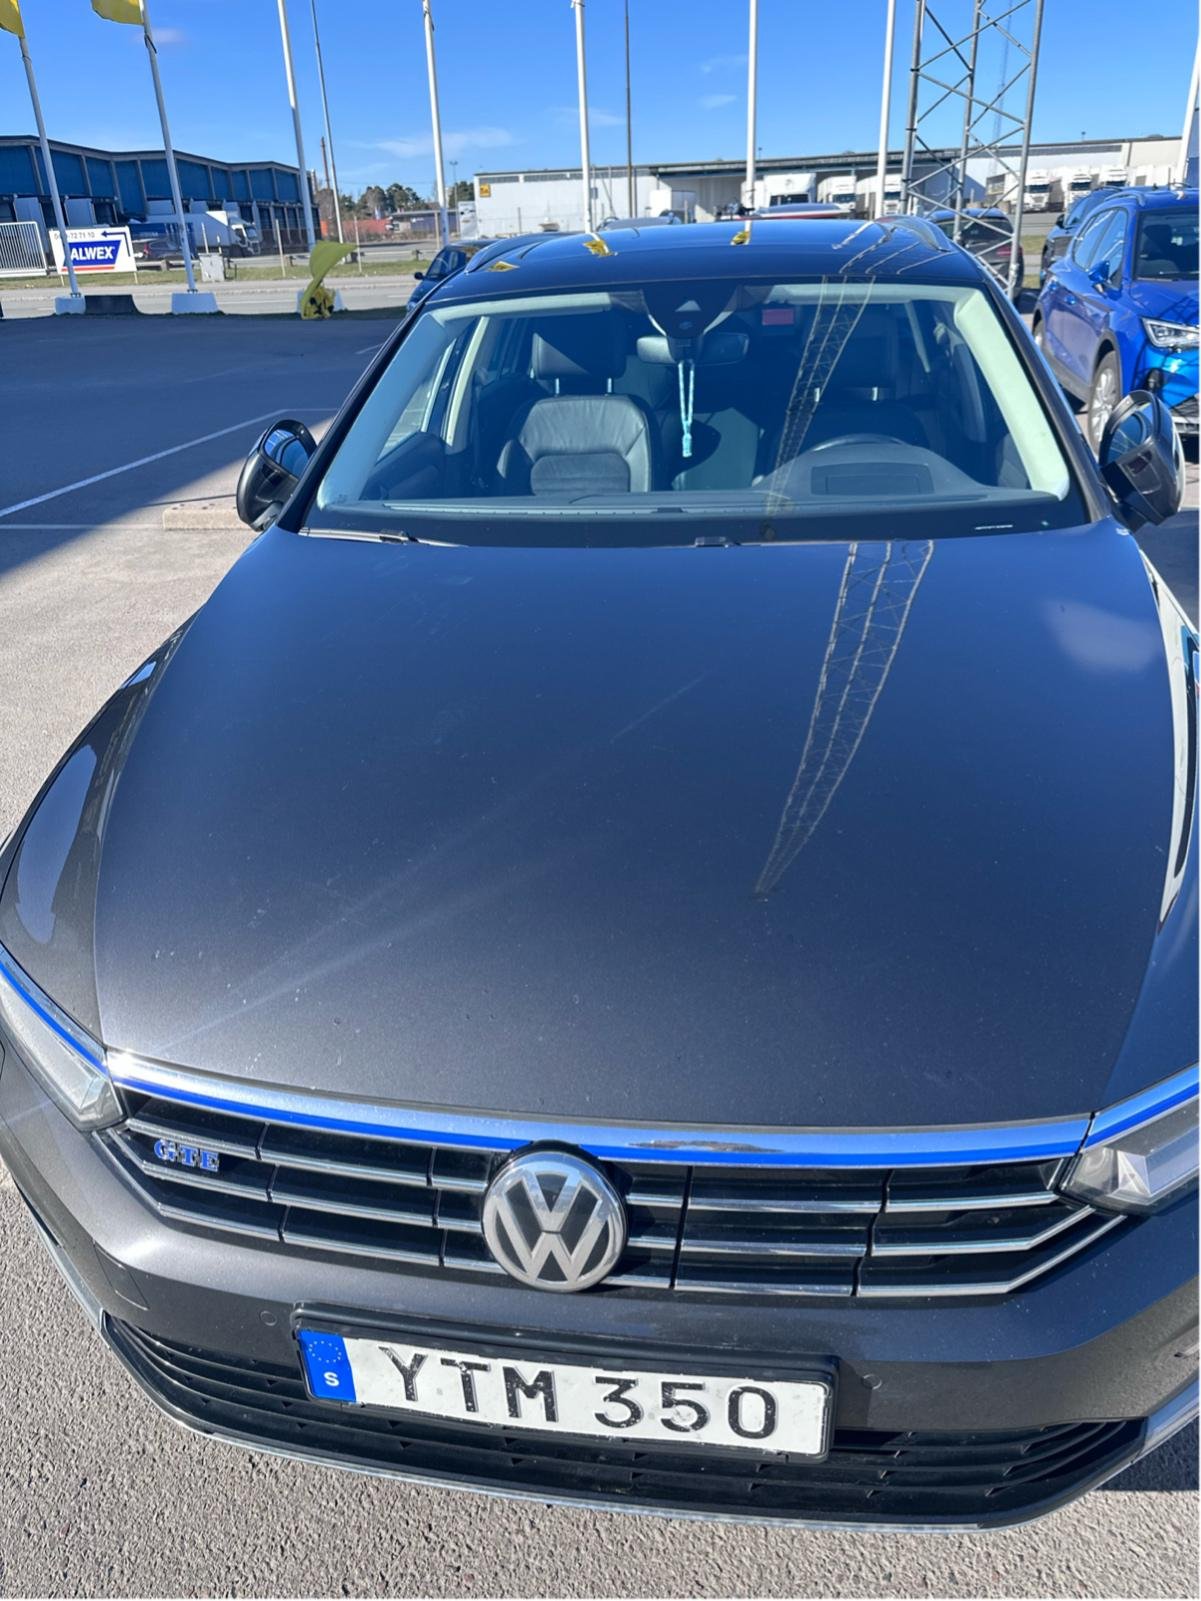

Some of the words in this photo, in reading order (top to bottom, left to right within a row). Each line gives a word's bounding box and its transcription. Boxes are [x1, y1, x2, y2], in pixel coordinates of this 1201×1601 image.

[71, 246, 114, 260] ALWEX
[154, 1139, 219, 1172] GTE
[324, 1371, 341, 1387] S
[378, 1346, 559, 1423] YTM
[594, 1376, 777, 1440] 350
